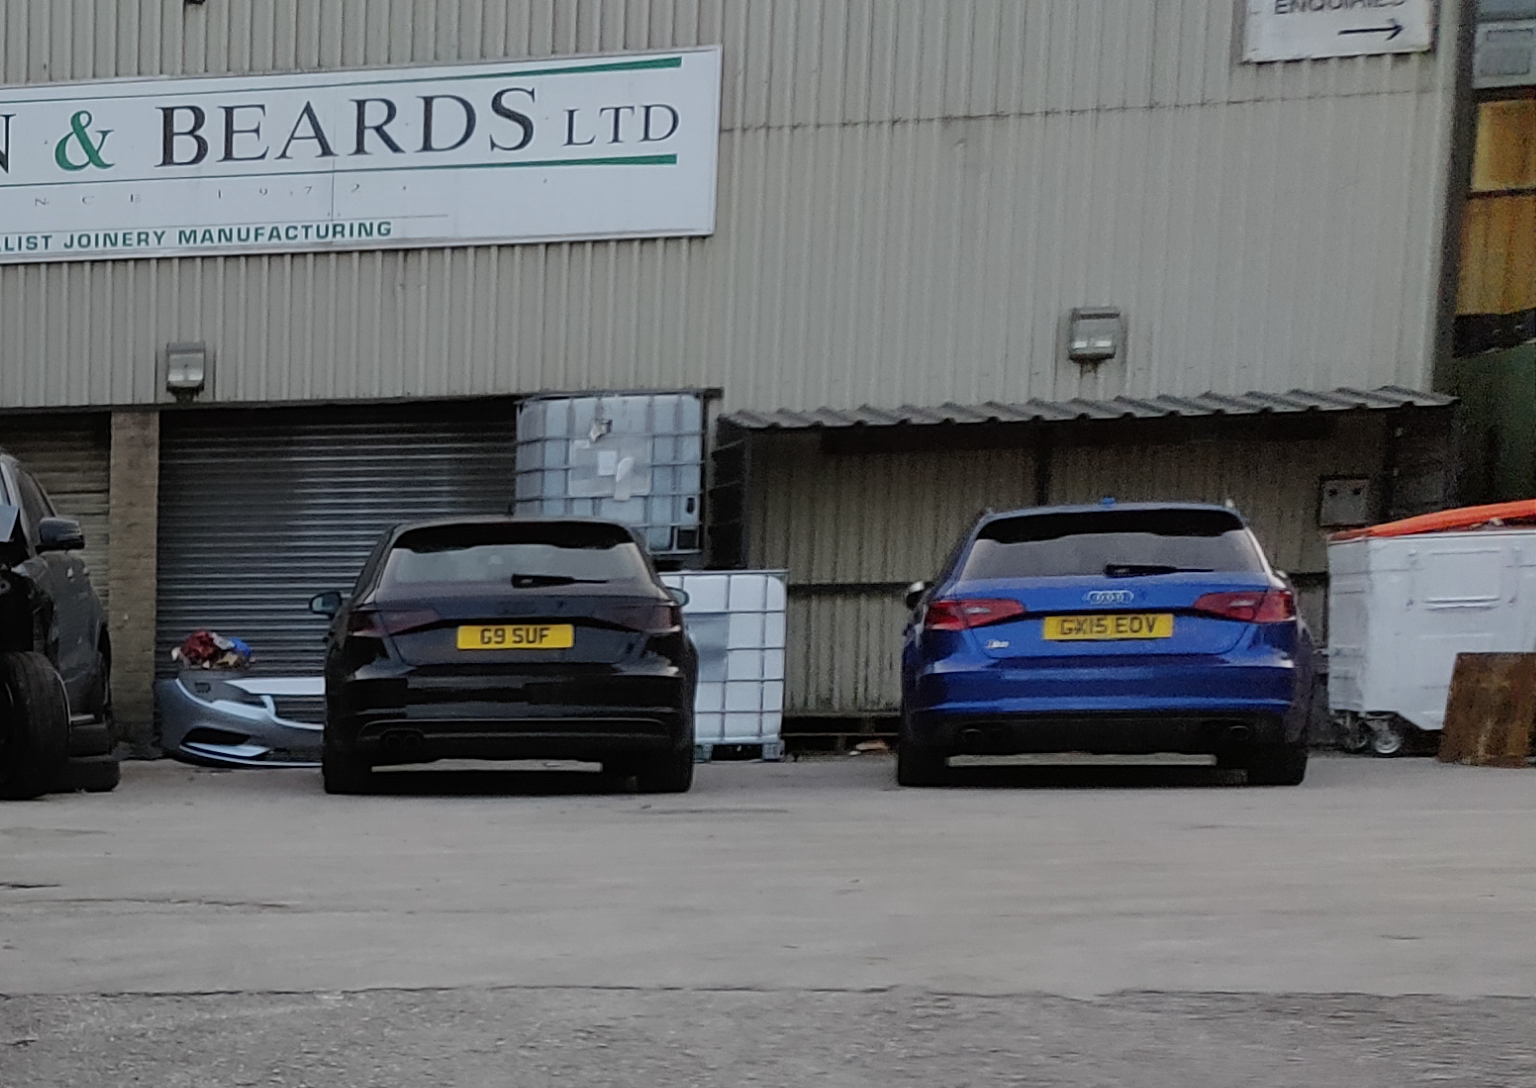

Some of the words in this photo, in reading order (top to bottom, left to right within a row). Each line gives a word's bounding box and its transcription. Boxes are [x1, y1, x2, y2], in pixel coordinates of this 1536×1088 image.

[54, 109, 116, 172] &
[153, 87, 537, 168] BEARDS
[561, 103, 680, 148] LTD
[63, 229, 167, 250] JOINERY
[178, 220, 393, 246] MANUFACTURING
[480, 627, 506, 645] G9
[512, 626, 550, 645] SUF
[1115, 615, 1158, 633] EOV
